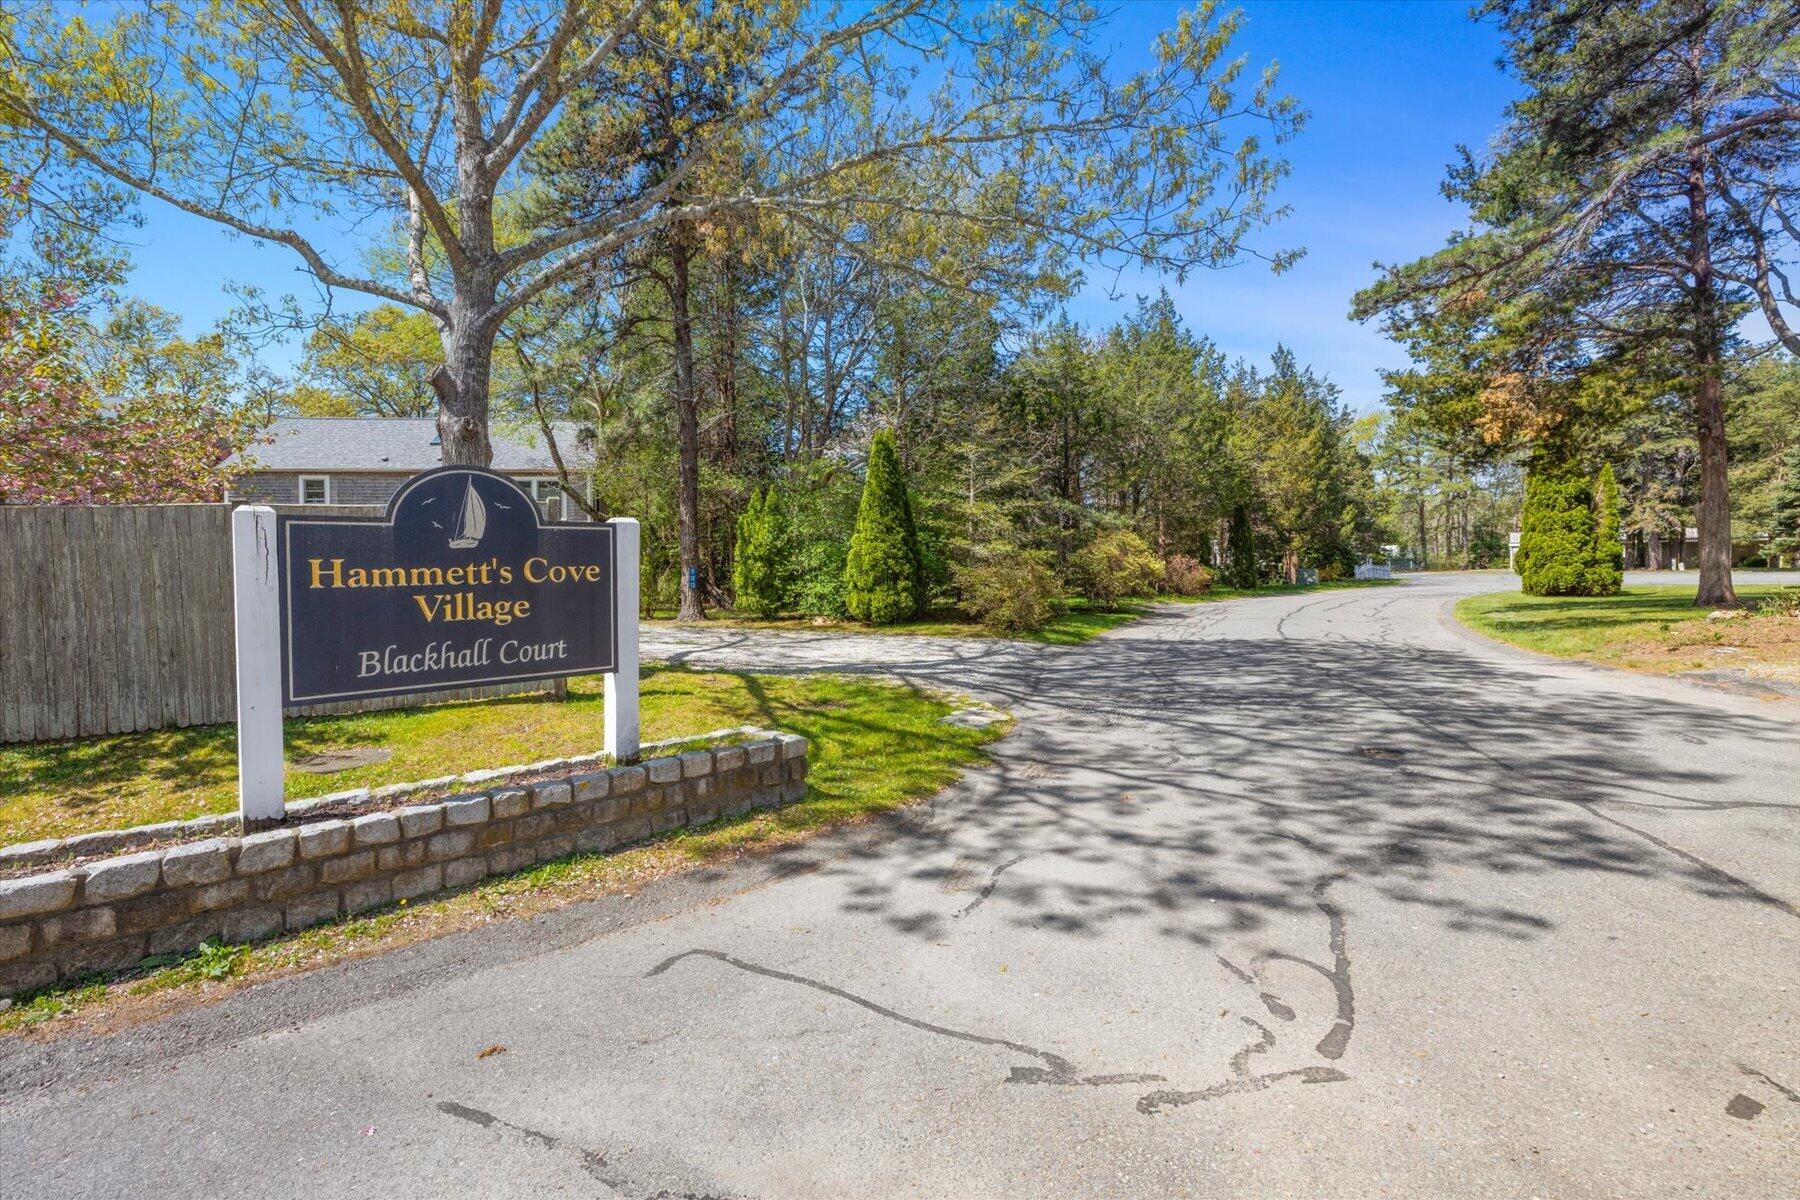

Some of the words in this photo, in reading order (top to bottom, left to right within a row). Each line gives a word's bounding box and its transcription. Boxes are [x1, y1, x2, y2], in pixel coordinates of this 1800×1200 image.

[308, 557, 512, 589] Hammett's
[523, 557, 601, 584] Cove
[413, 592, 531, 626] Village
[357, 638, 493, 678] Blackhall
[499, 640, 568, 665] Court
